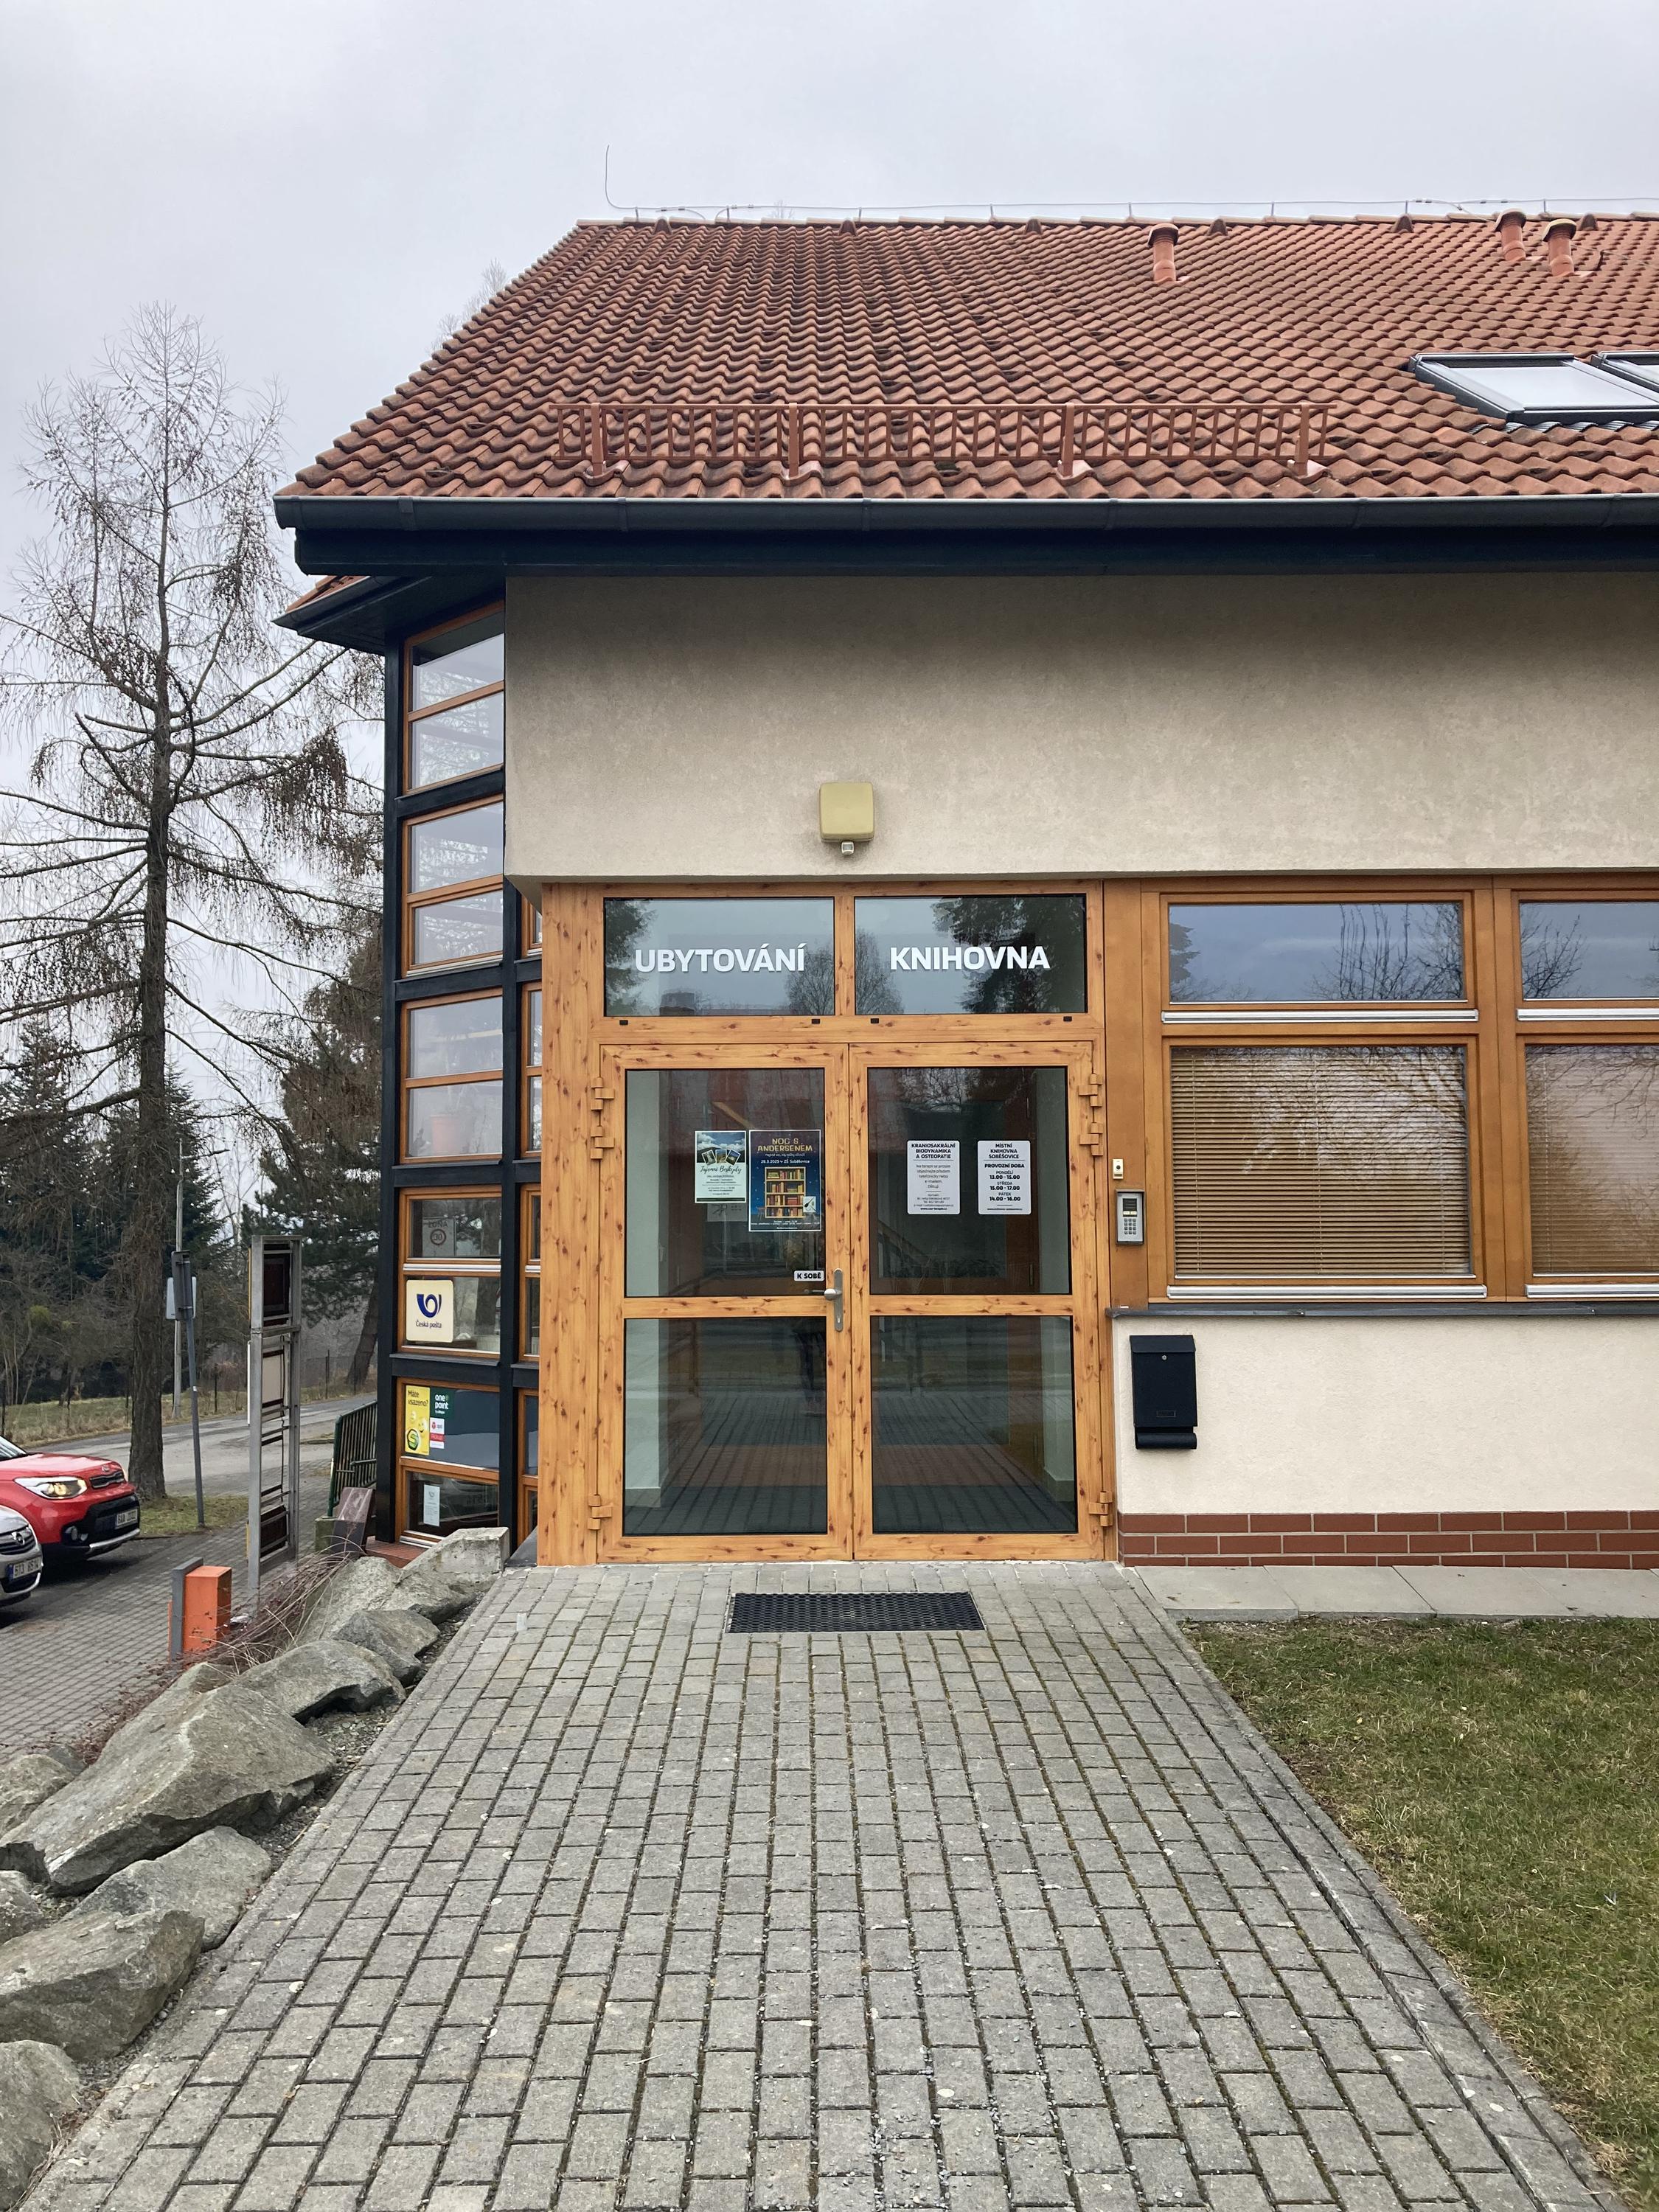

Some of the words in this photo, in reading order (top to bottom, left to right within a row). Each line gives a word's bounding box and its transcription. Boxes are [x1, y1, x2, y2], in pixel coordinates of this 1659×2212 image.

[635, 943, 807, 973] UBYTOVÁNÍ
[890, 945, 1051, 971] KNIHOVNA
[416, 1319, 429, 1327] Česká
[434, 1402, 449, 1410] point
